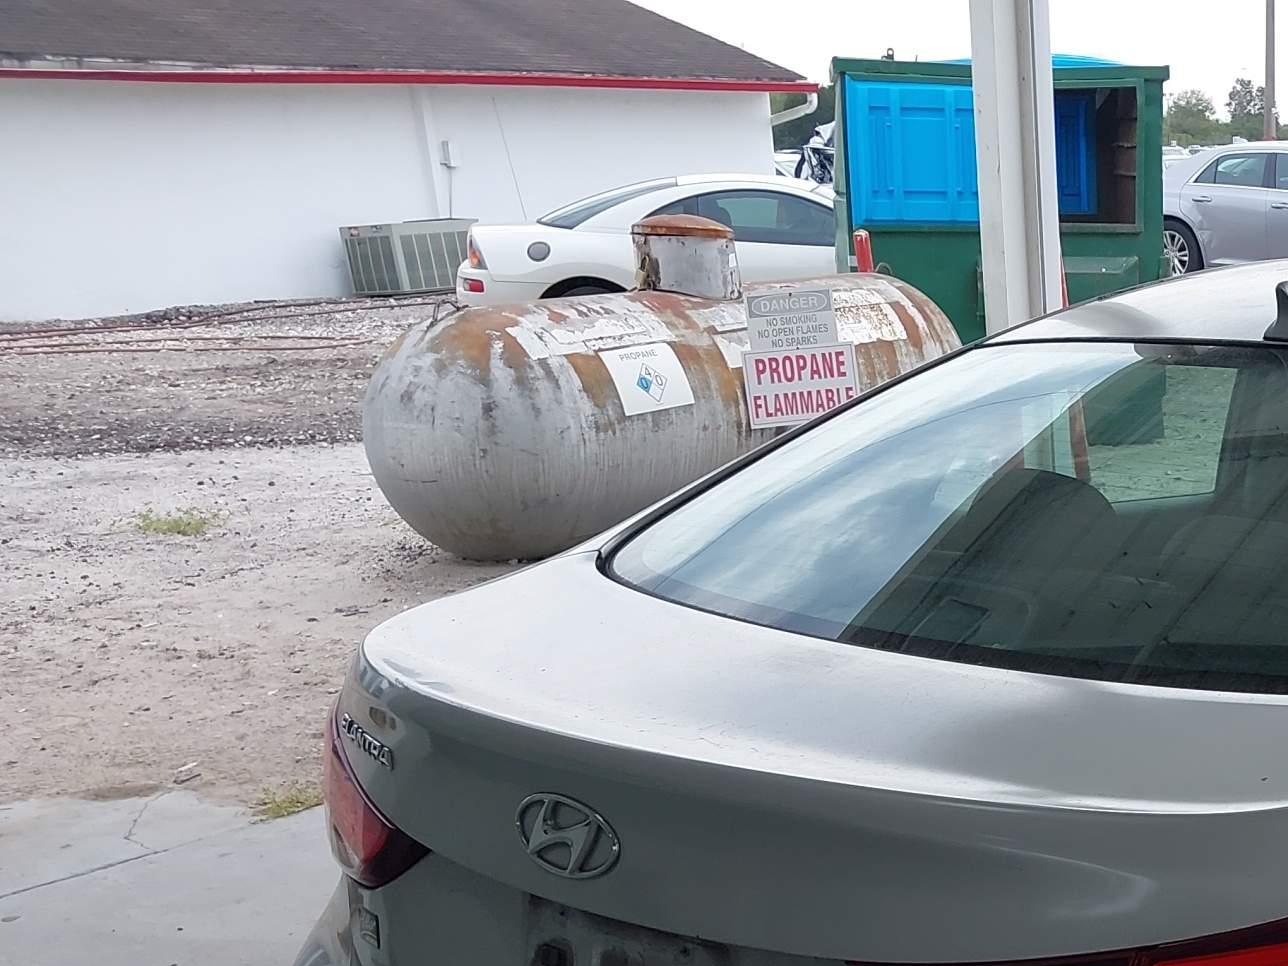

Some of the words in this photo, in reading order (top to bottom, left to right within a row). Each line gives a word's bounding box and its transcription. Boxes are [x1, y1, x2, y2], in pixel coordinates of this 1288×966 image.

[760, 296, 818, 312] DANGER
[766, 318, 778, 327] NO
[780, 314, 817, 325] SMOKING
[758, 329, 770, 339] NO
[772, 327, 794, 338] OPEN
[796, 323, 829, 335] FLAMES
[771, 339, 784, 348] NO
[785, 335, 818, 347] SPARKS
[619, 350, 658, 361] PROPANE
[644, 367, 652, 377] 4
[754, 350, 847, 385] PROPANE
[341, 711, 394, 771] ELANTRA
